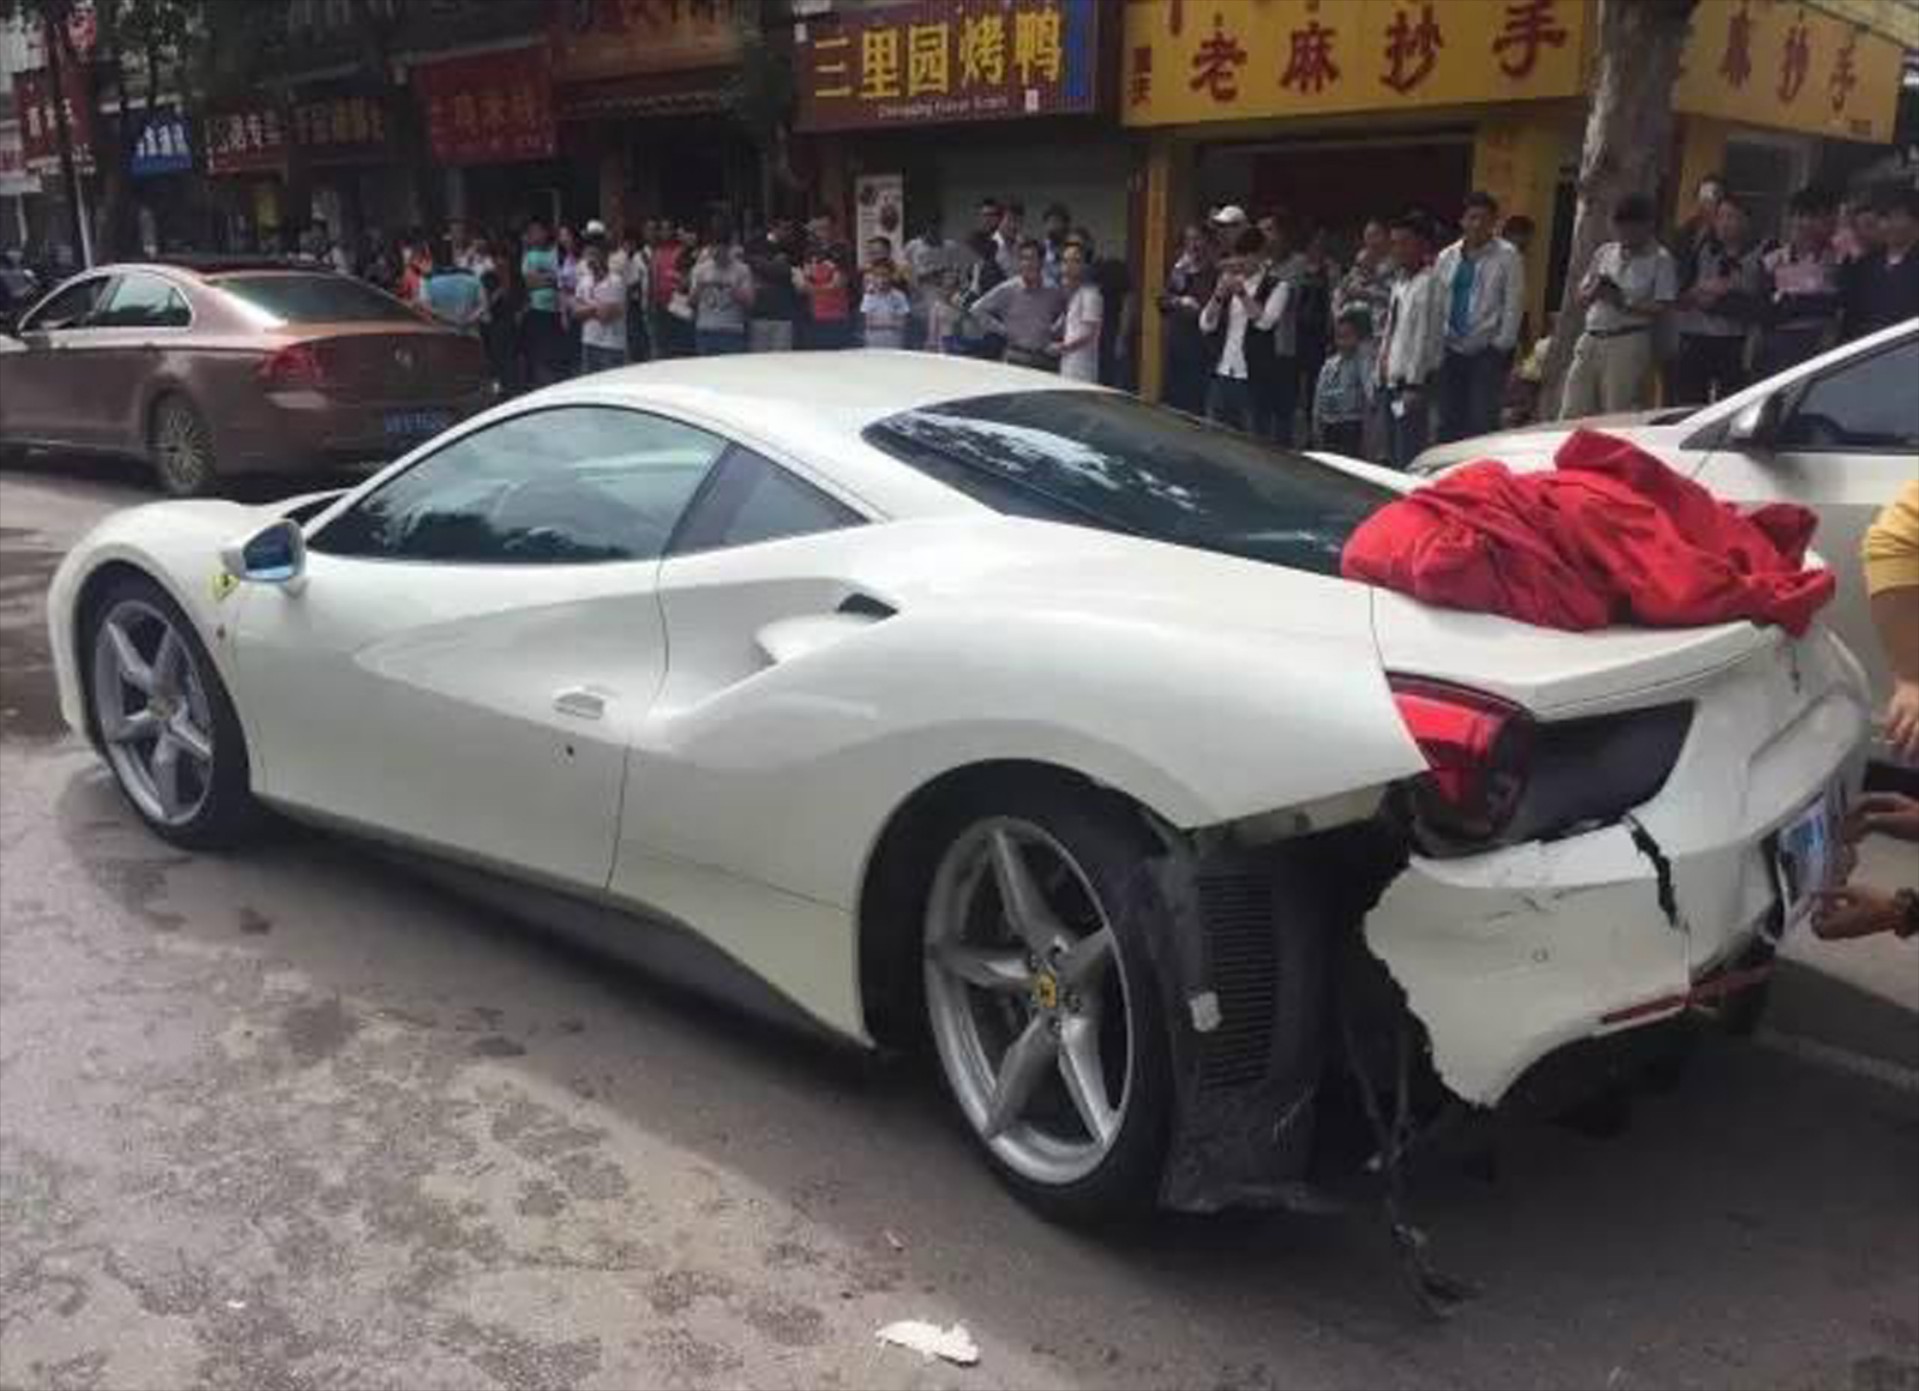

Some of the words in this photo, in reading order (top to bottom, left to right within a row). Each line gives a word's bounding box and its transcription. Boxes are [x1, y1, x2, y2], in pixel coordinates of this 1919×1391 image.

[1189, 0, 1566, 101] 老麻抄手
[1676, 14, 1857, 114] 麻抄手
